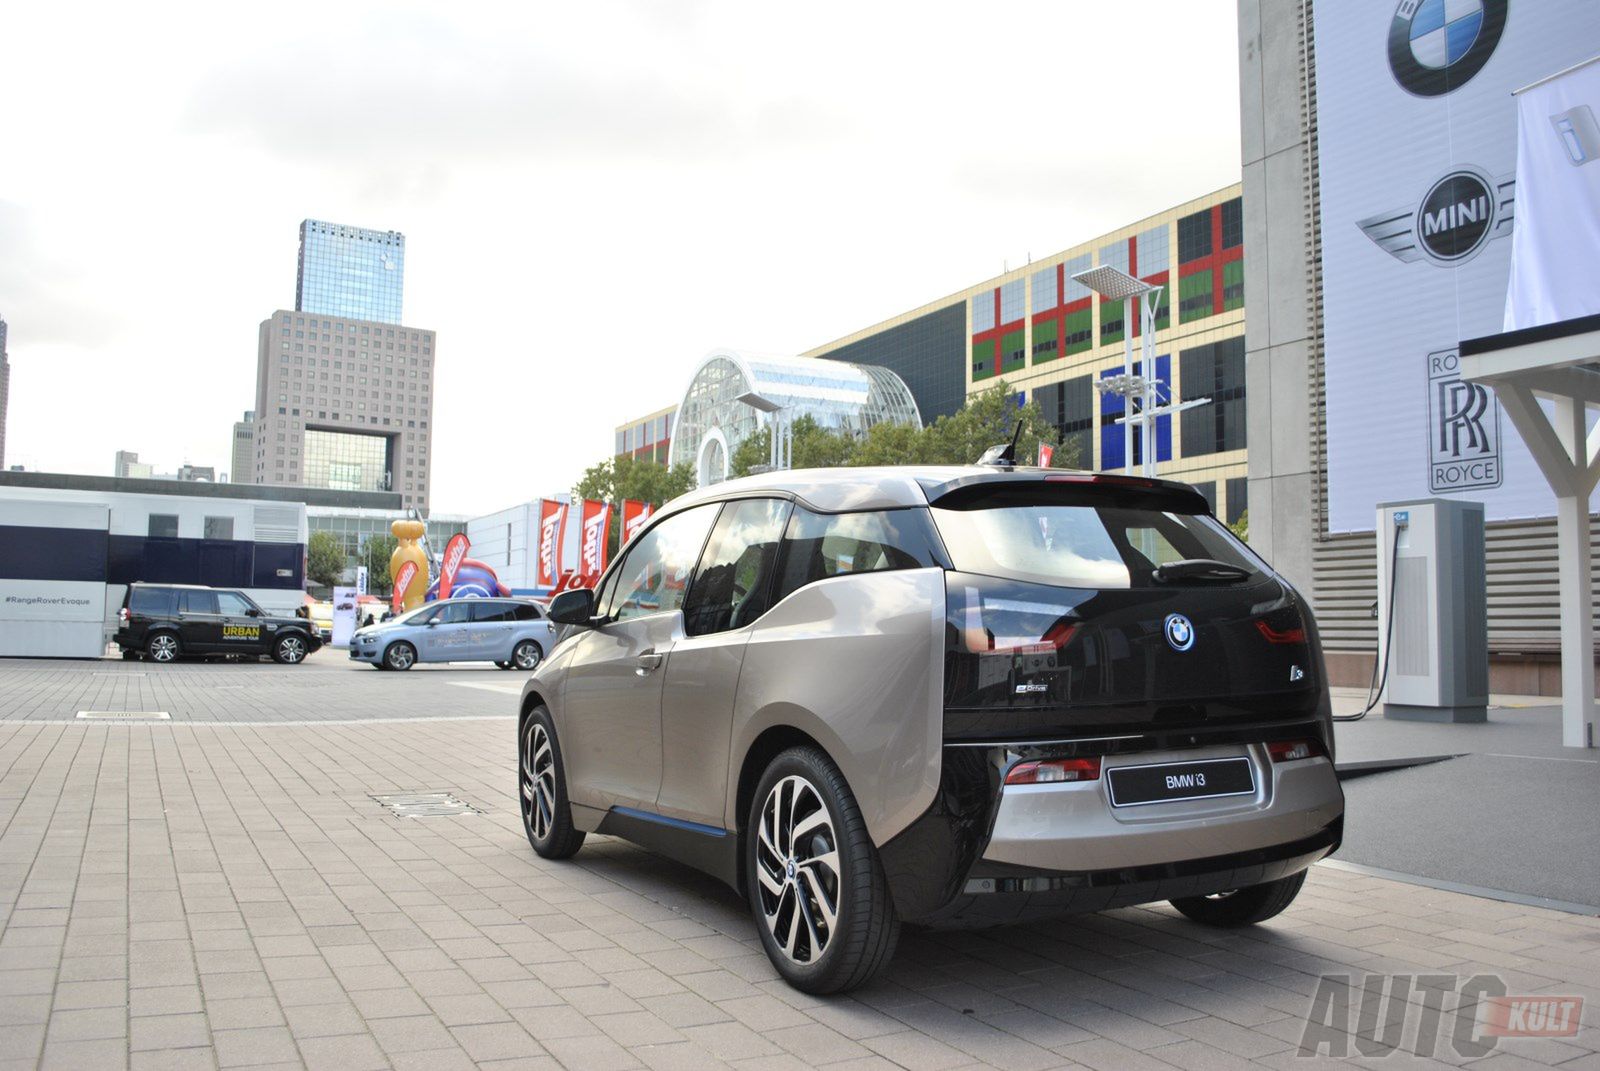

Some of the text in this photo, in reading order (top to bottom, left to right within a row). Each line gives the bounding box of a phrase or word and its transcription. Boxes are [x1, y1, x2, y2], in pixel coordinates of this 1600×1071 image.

[1424, 195, 1486, 237] MINI
[1436, 462, 1494, 484] ROYCE
[6, 596, 91, 606] #RangeRoverEvoque
[223, 626, 260, 636] URBAN
[1165, 773, 1206, 789] BMW i3
